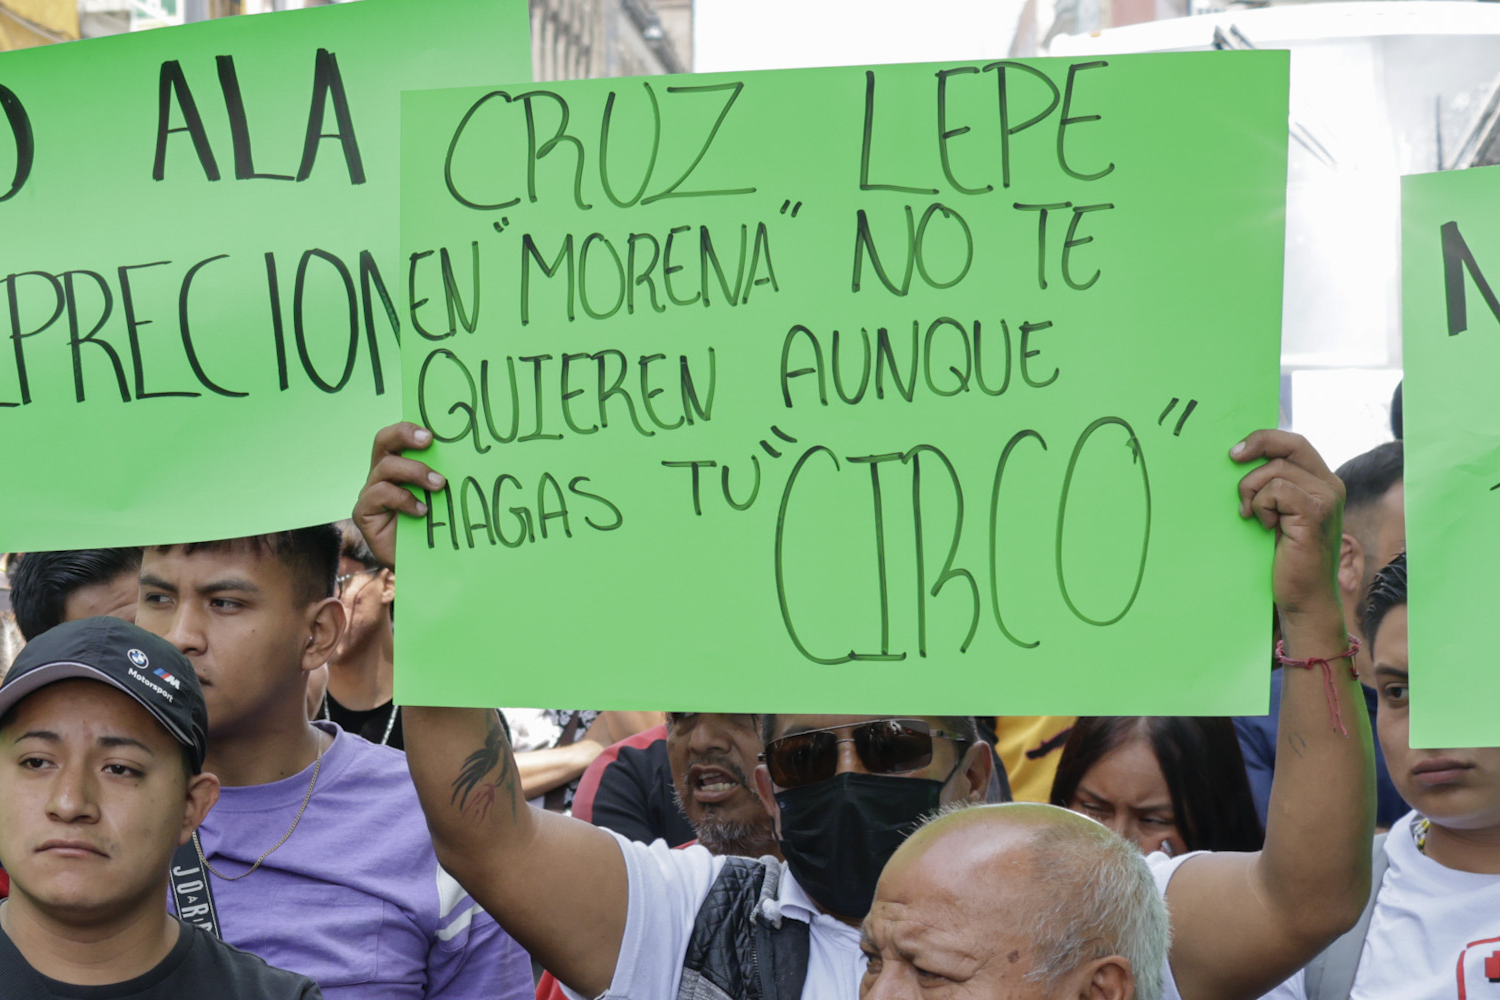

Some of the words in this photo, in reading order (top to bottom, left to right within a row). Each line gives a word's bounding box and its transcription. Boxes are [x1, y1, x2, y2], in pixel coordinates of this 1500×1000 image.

[444, 81, 757, 210] CRUZ
[859, 61, 1115, 195] LEPE
[408, 237, 481, 341] EN
[852, 203, 973, 297] NO
[1013, 202, 1115, 290] TE
[418, 346, 717, 453] QUIEREN
[781, 316, 1060, 408] AUNQUE
[424, 472, 623, 551] HAGAS
[661, 454, 761, 516] TU
[128, 667, 174, 703] Motorsport
